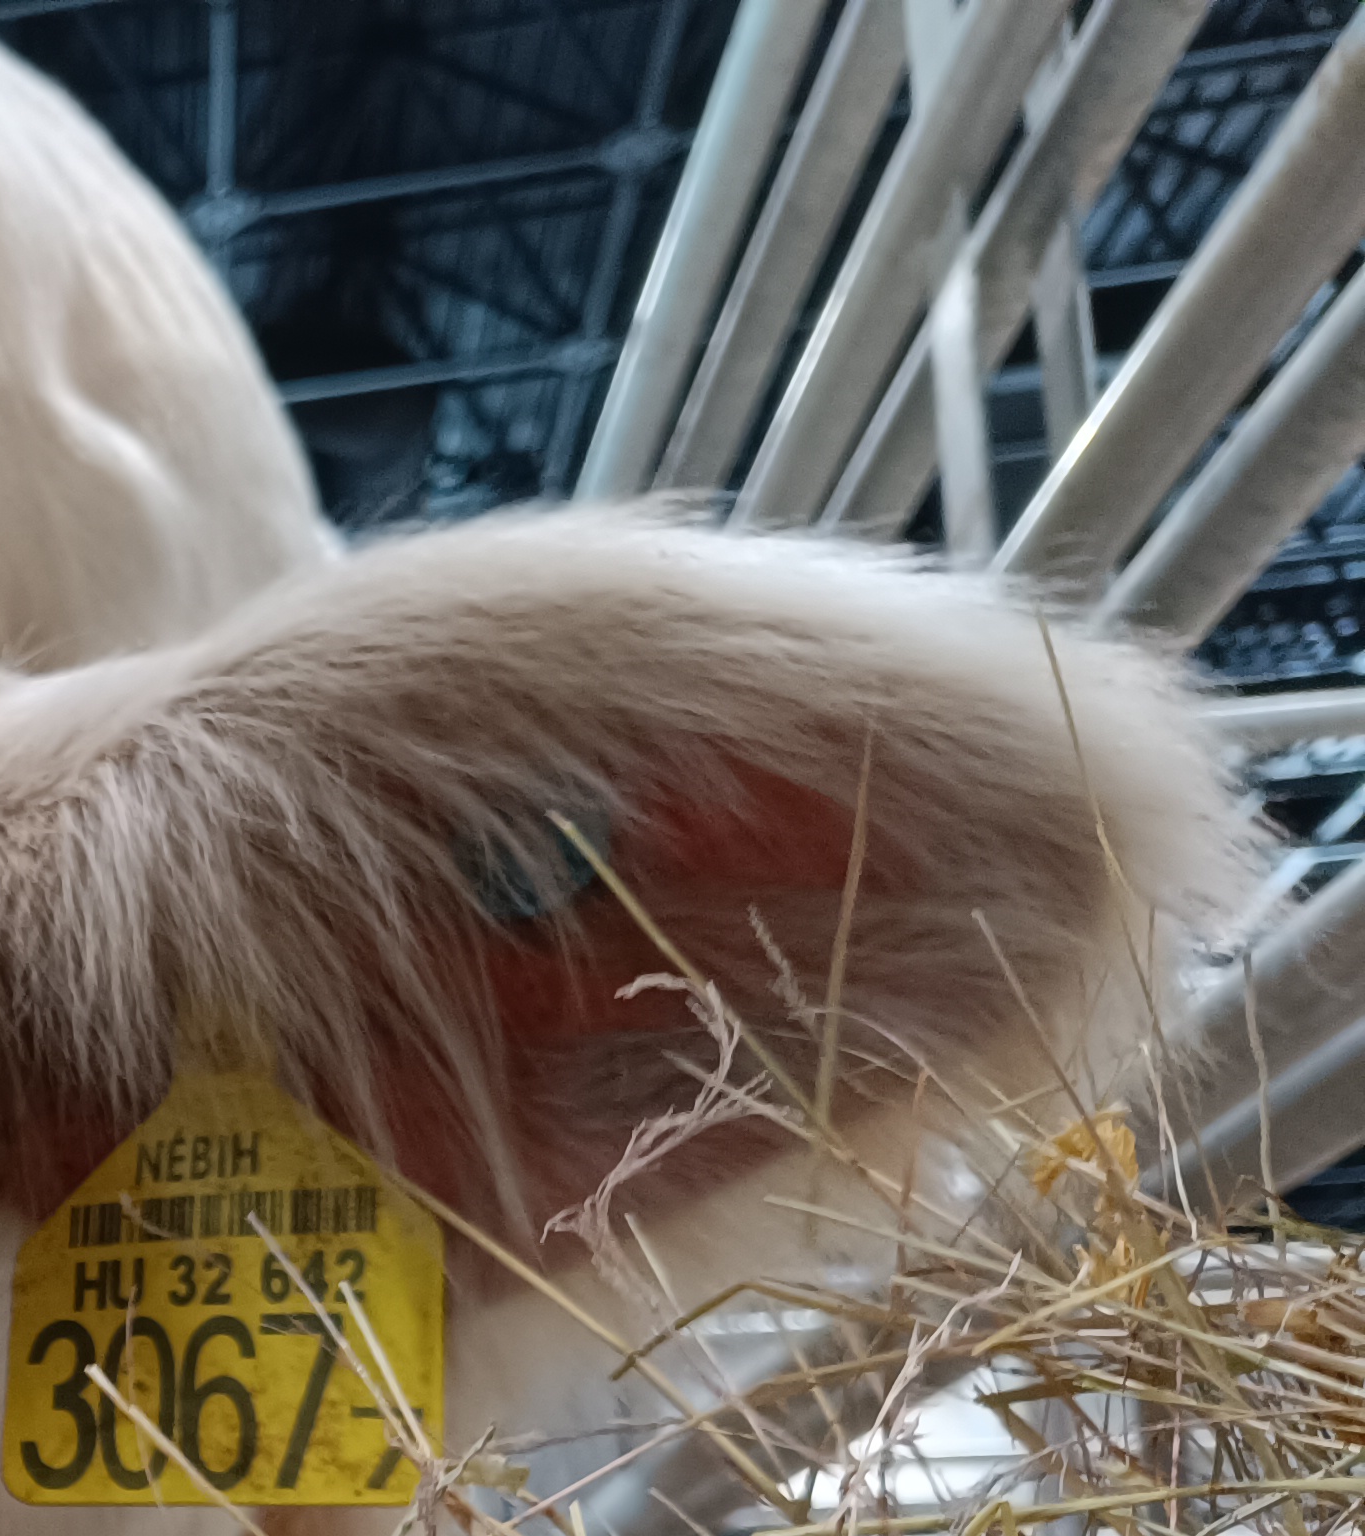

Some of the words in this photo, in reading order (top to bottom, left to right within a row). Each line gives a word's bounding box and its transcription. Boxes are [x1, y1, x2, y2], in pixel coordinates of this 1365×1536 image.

[135, 1130, 261, 1185] NÉBIH
[74, 1257, 144, 1312] HU
[168, 1252, 232, 1306] 32
[260, 1248, 365, 1304] 642
